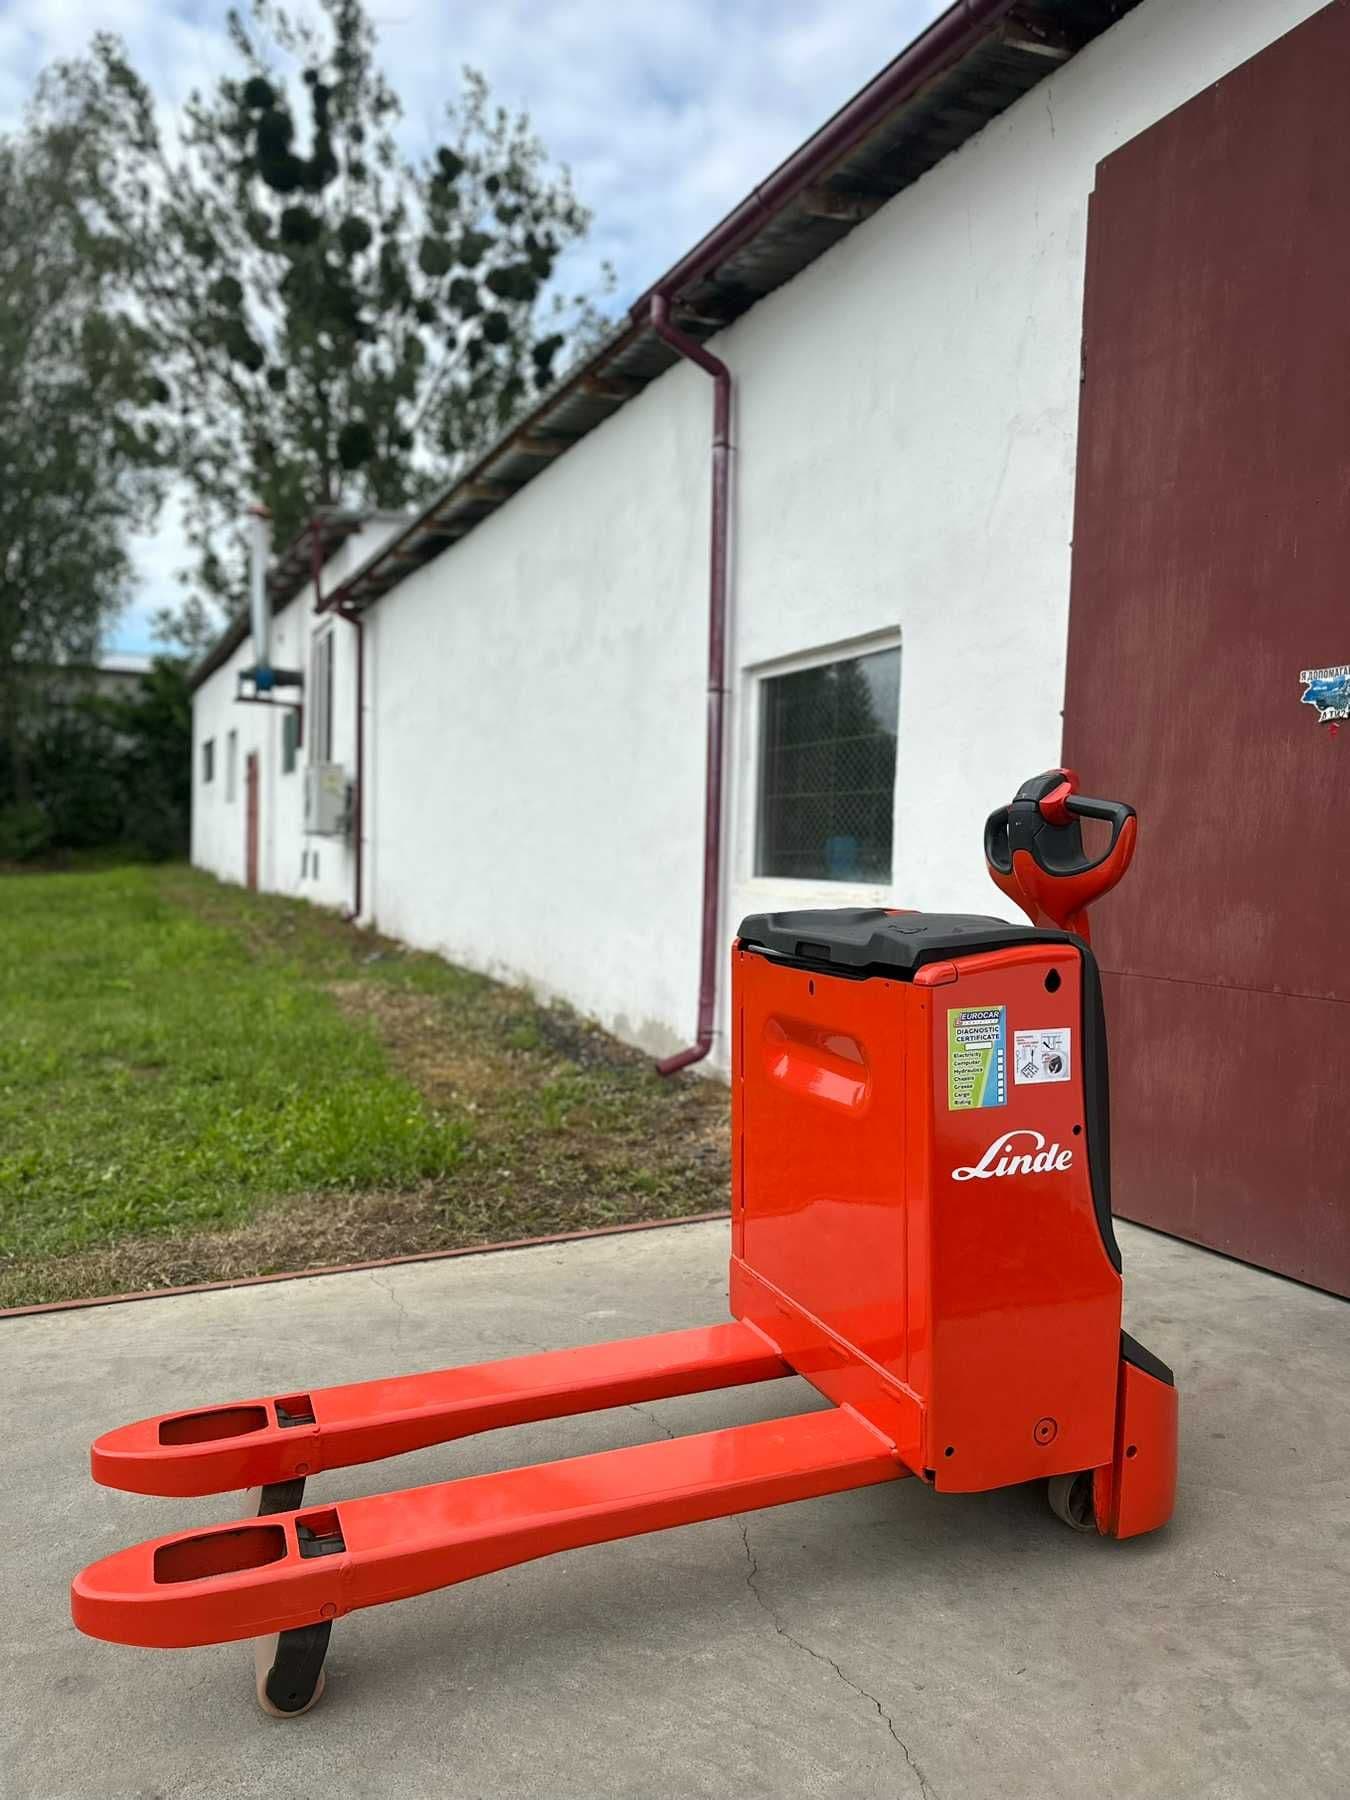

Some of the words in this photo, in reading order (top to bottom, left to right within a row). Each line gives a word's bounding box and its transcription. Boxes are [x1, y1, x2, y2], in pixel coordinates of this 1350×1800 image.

[1301, 672, 1306, 681] Я
[1307, 667, 1350, 681] ДОПОМАГА
[961, 1010, 1000, 1020] EUROCAR
[956, 1026, 999, 1035] DIAGNOSTIC
[956, 1034, 1000, 1042] CERTIFICATE
[951, 1129, 1073, 1182] Linde
